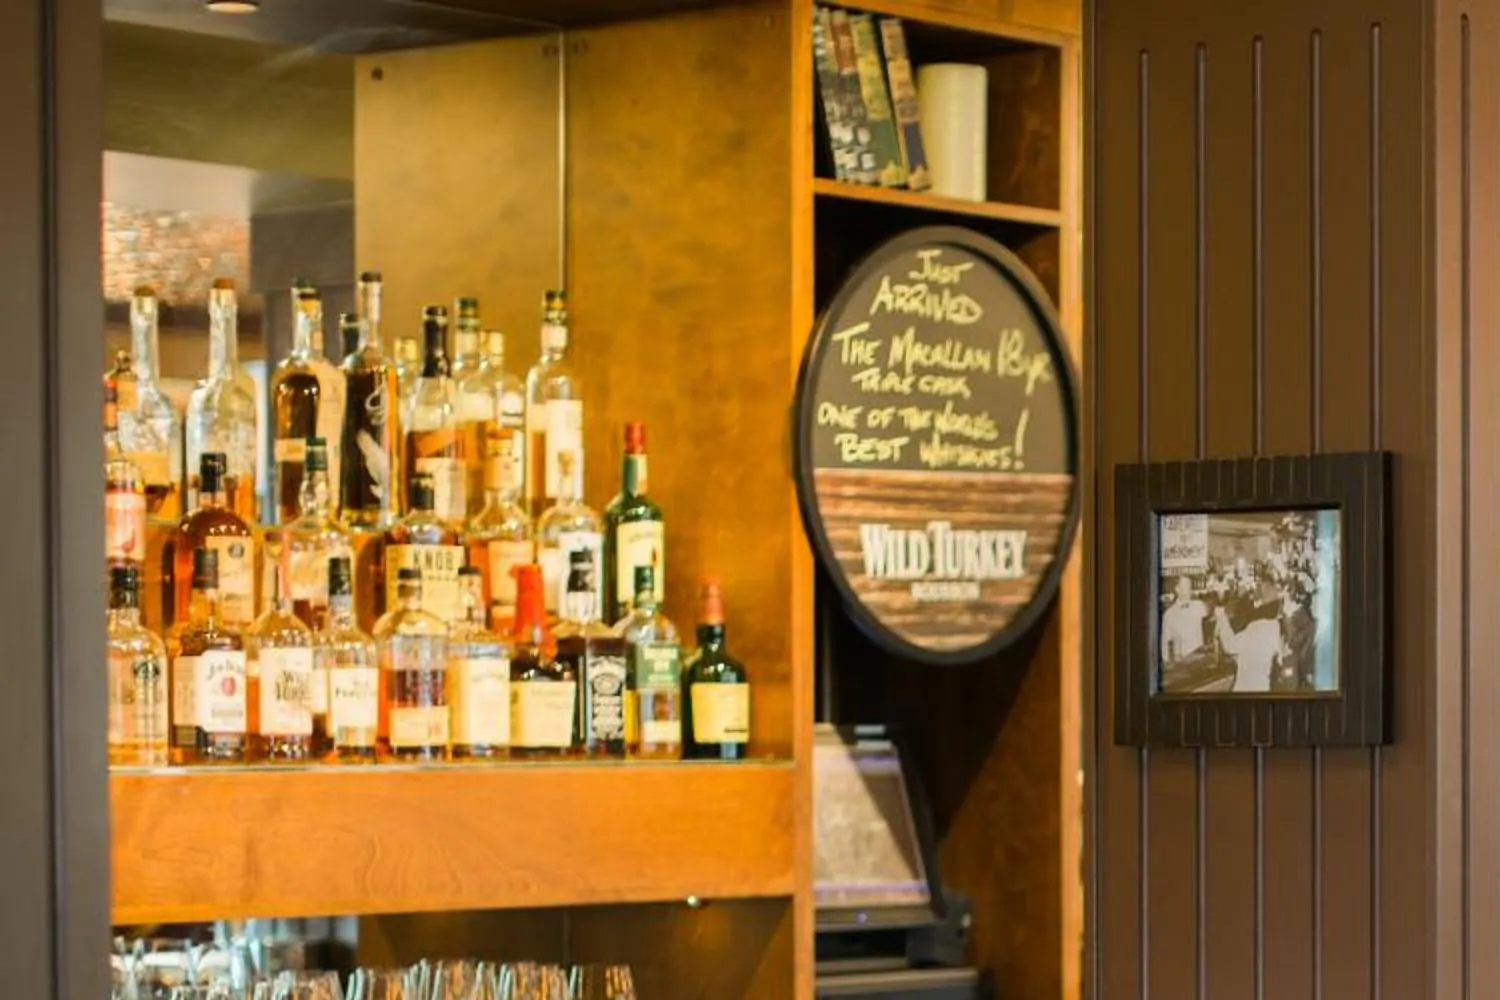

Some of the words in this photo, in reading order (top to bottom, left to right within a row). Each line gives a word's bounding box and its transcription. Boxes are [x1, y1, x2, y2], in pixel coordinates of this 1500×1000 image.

[817, 401, 864, 429] ONE
[866, 405, 896, 429] OF
[834, 432, 910, 463] BEST
[859, 523, 930, 579] WILD
[927, 520, 1028, 580] TURKEY
